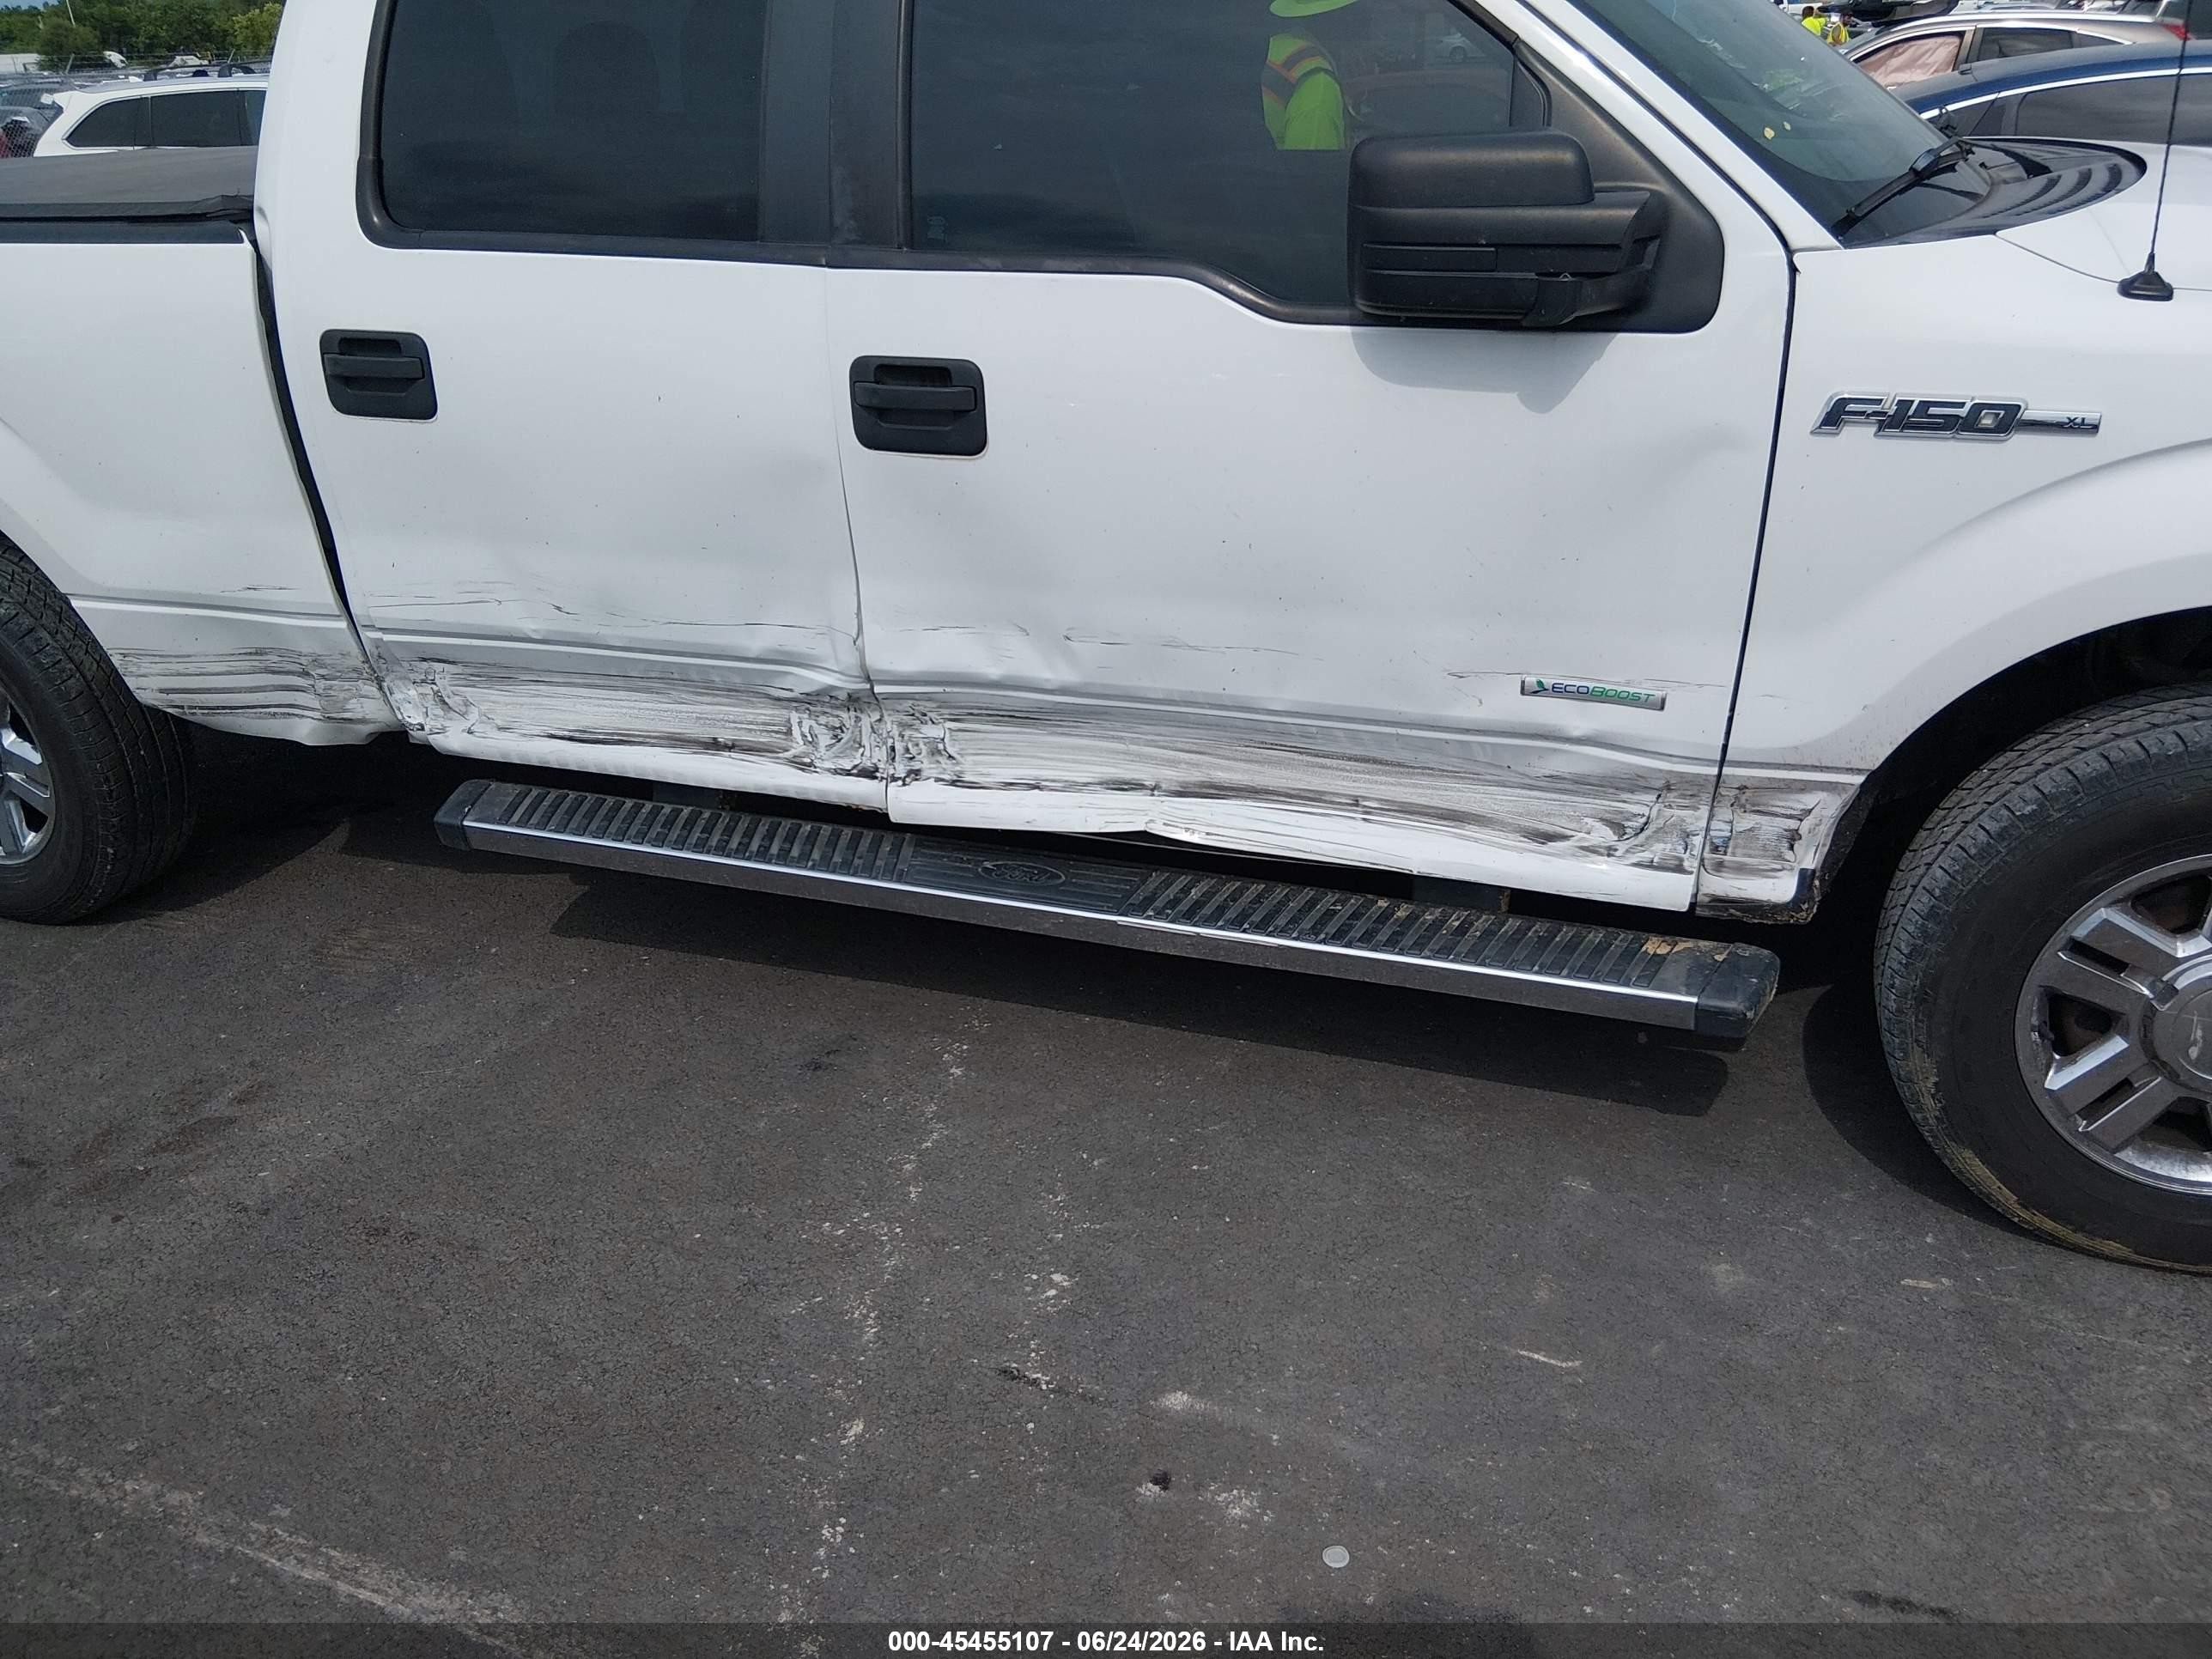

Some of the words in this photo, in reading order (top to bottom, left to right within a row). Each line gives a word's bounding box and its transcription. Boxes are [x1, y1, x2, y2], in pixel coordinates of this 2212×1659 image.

[1811, 392, 2027, 440] F-150
[2063, 416, 2093, 428] XL
[1551, 682, 1656, 703] ECOBOOST
